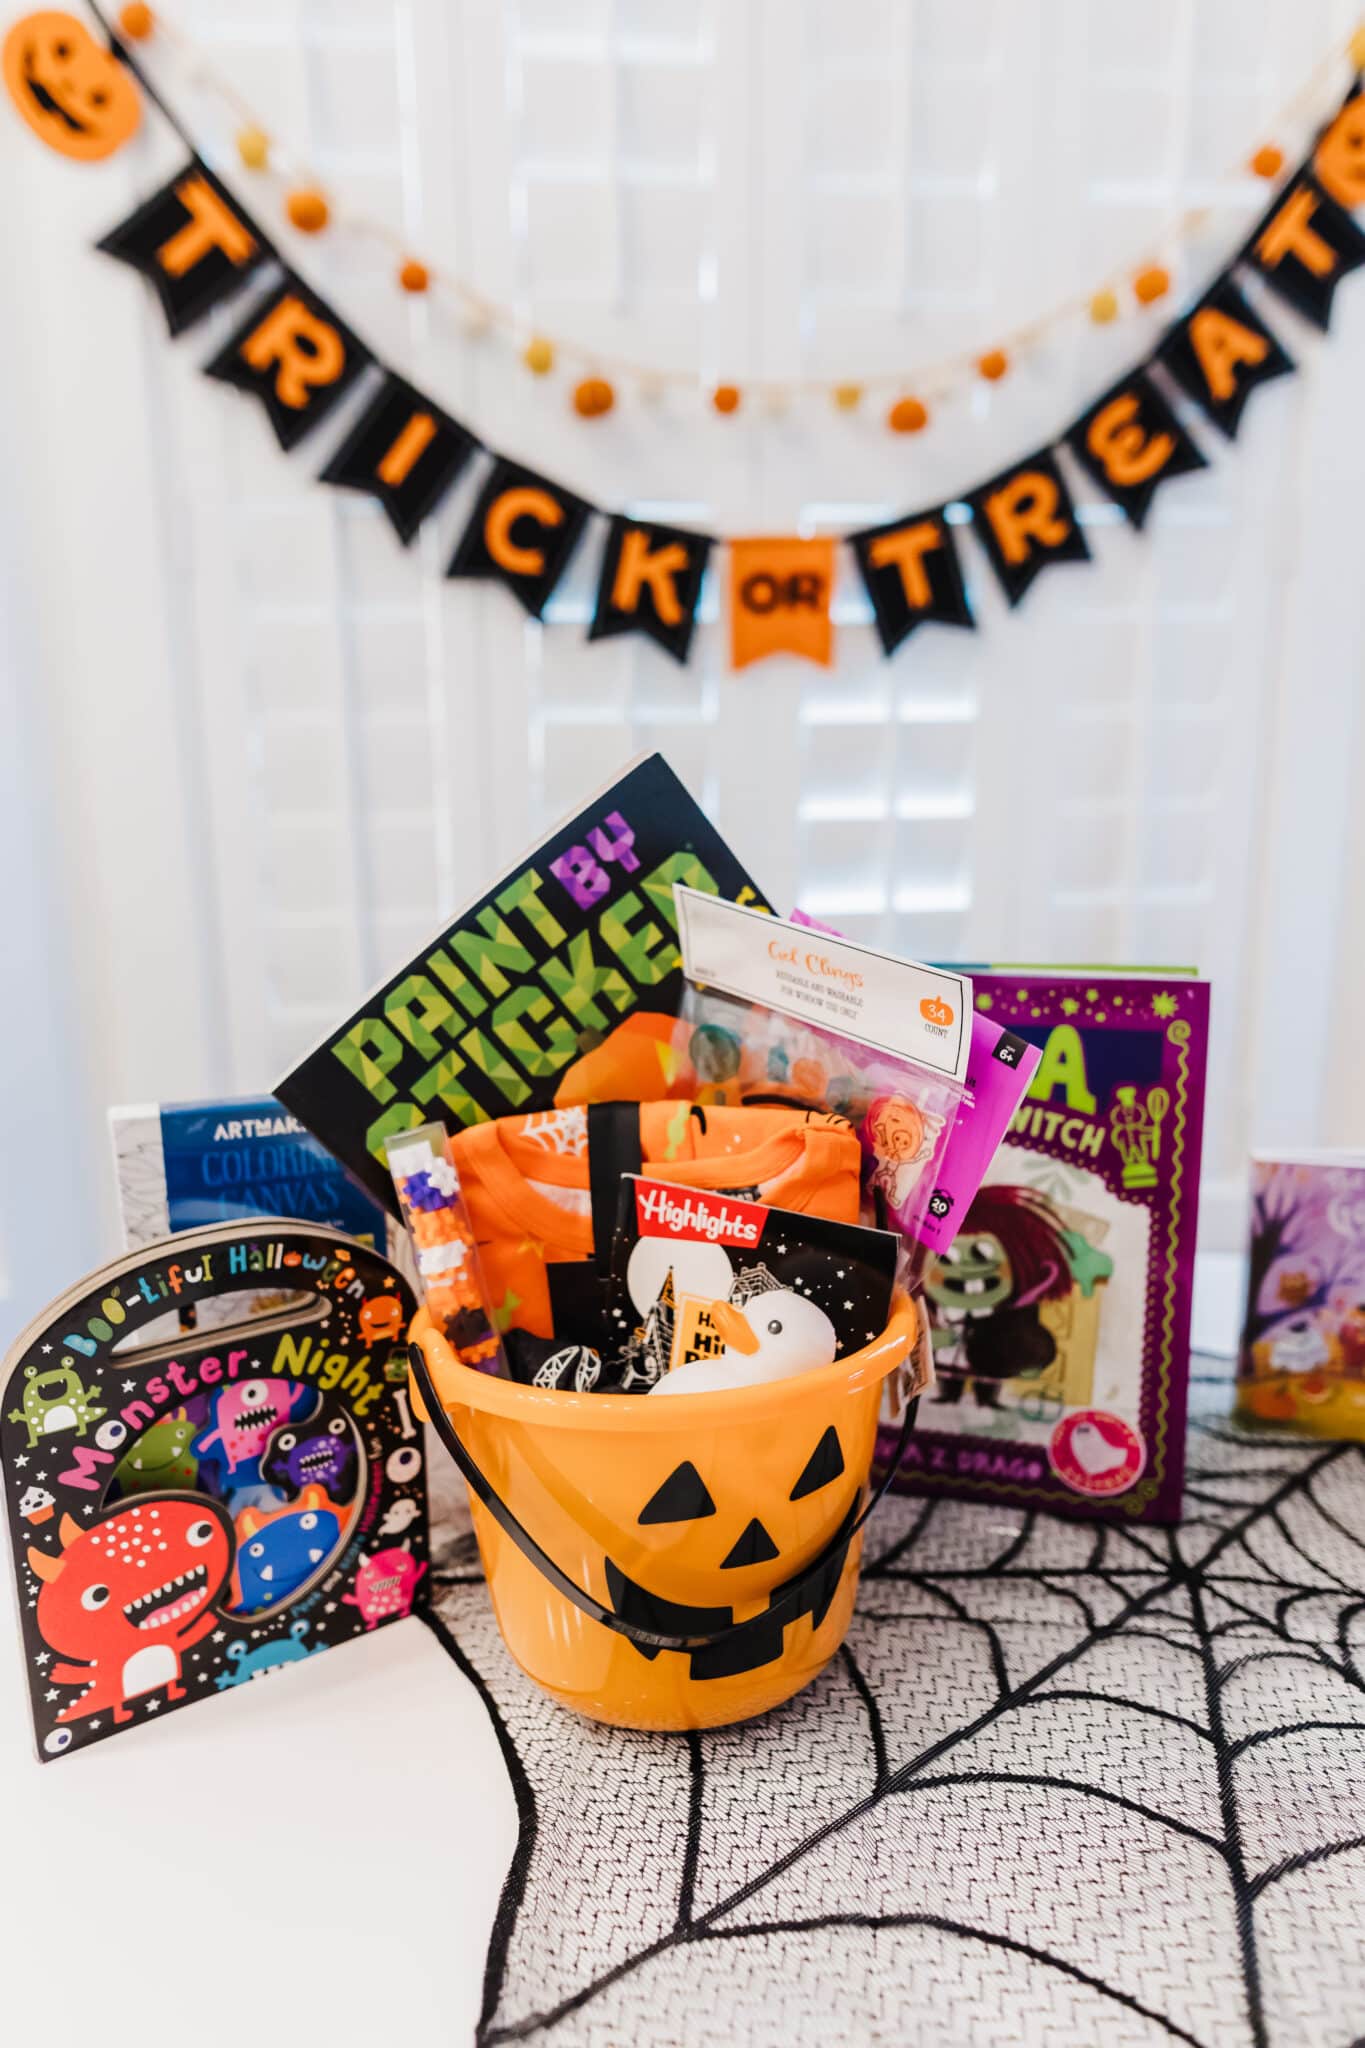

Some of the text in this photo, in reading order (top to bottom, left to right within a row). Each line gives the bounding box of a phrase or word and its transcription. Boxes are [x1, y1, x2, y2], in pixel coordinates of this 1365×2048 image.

[157, 173, 1339, 627] TRICK OR TREAT
[331, 810, 641, 1106] PAINT BY
[927, 1004, 946, 1023] 34
[999, 1048, 1014, 1063] 6+
[213, 1115, 307, 1142] ARTMAK
[638, 1189, 758, 1241] Highlights
[931, 1197, 948, 1213] 20
[229, 1243, 366, 1299] Halloween
[57, 1350, 248, 1491] Monster
[272, 1333, 384, 1416] Night
